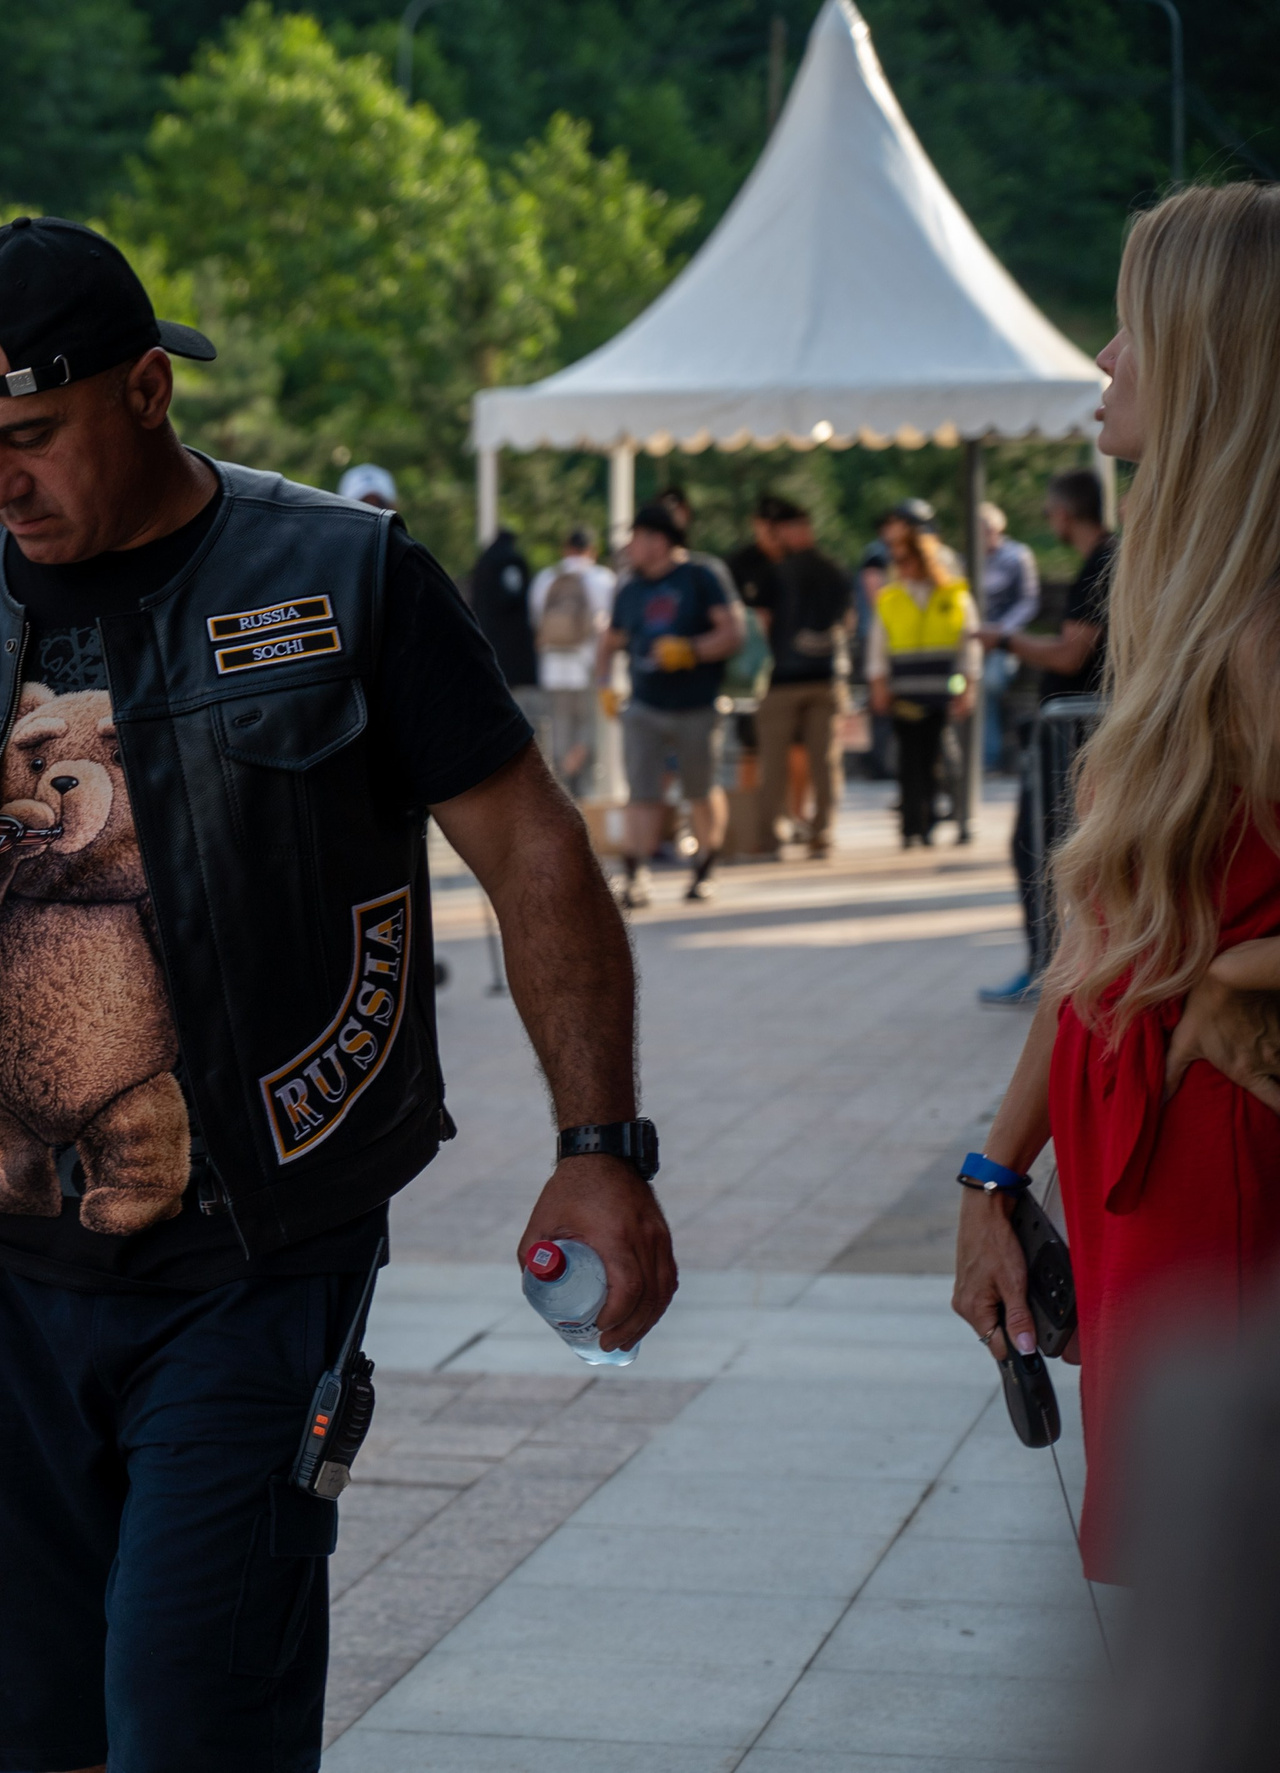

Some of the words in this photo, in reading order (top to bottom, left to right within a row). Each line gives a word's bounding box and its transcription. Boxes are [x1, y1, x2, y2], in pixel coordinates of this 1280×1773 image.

[238, 605, 301, 631] RUSSIA
[252, 638, 305, 661] SOCHI
[274, 907, 405, 1142] RUSSIA
